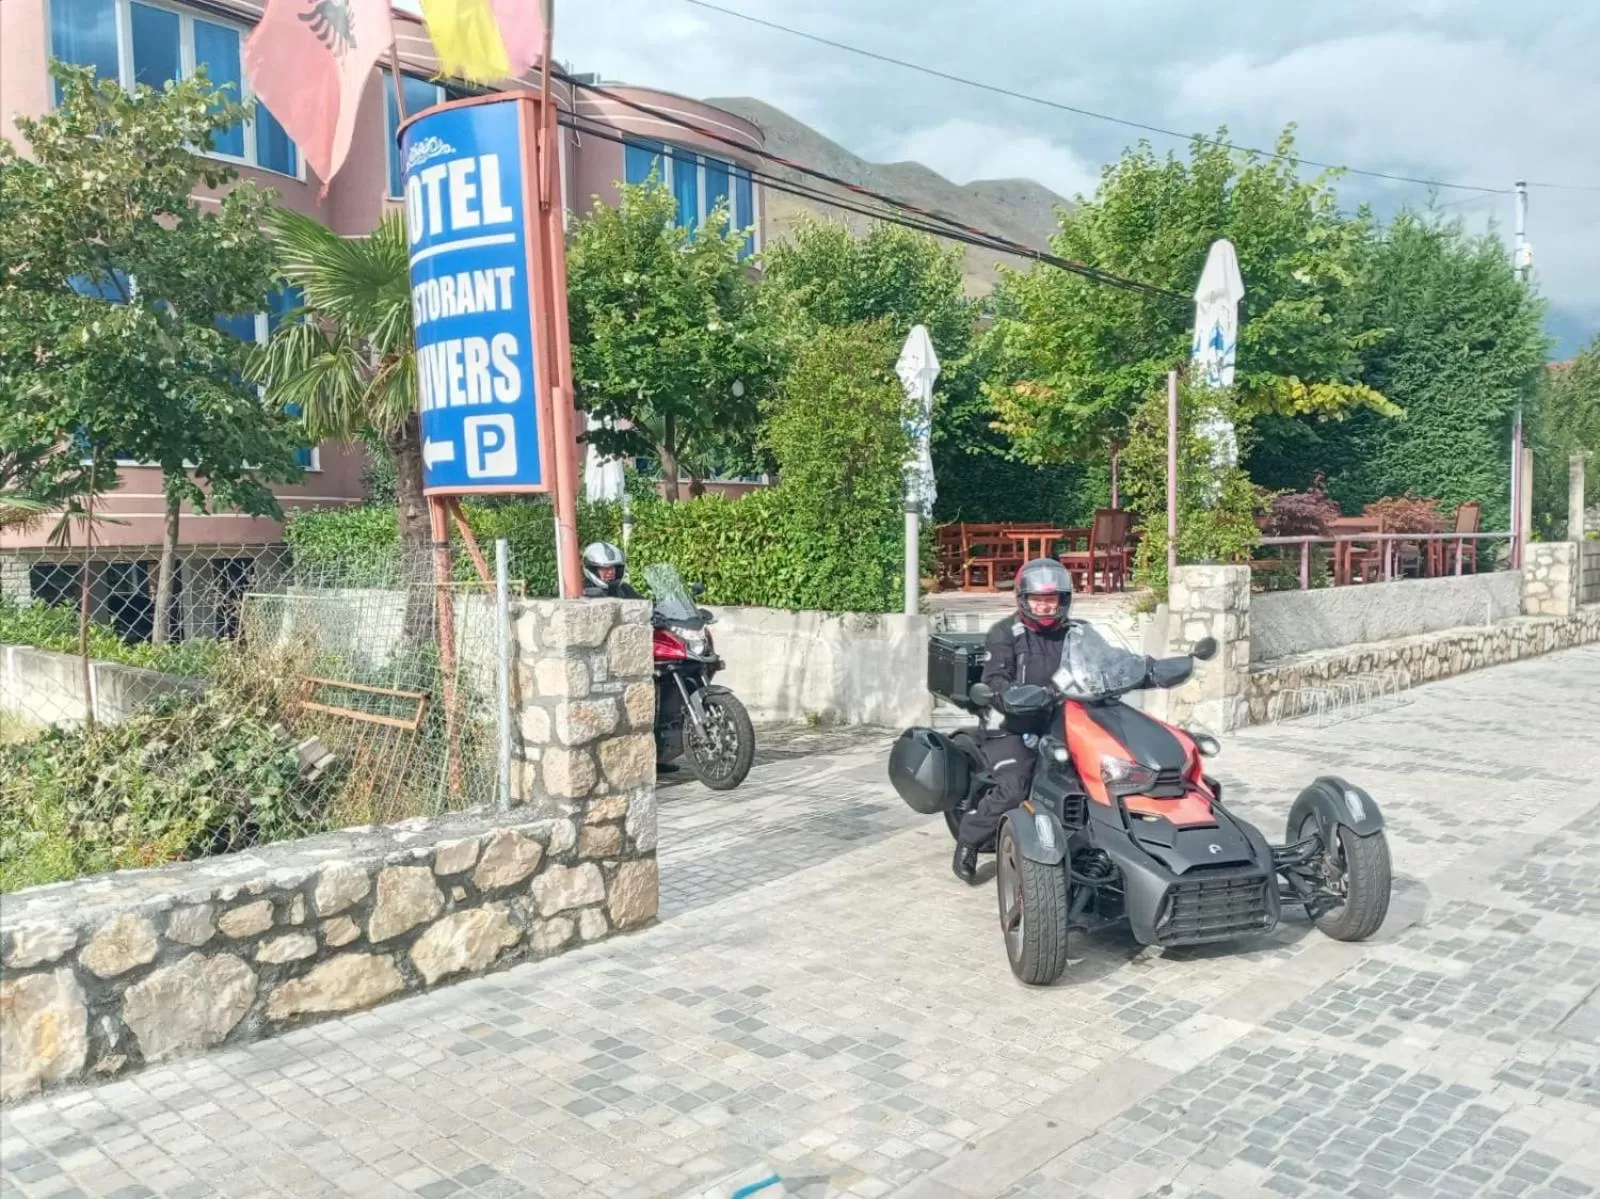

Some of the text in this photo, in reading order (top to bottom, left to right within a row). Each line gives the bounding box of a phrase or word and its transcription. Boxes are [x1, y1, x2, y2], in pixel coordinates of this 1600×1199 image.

[407, 154, 513, 245] OTEL
[412, 266, 516, 328] STORANT
[476, 423, 506, 471] P
